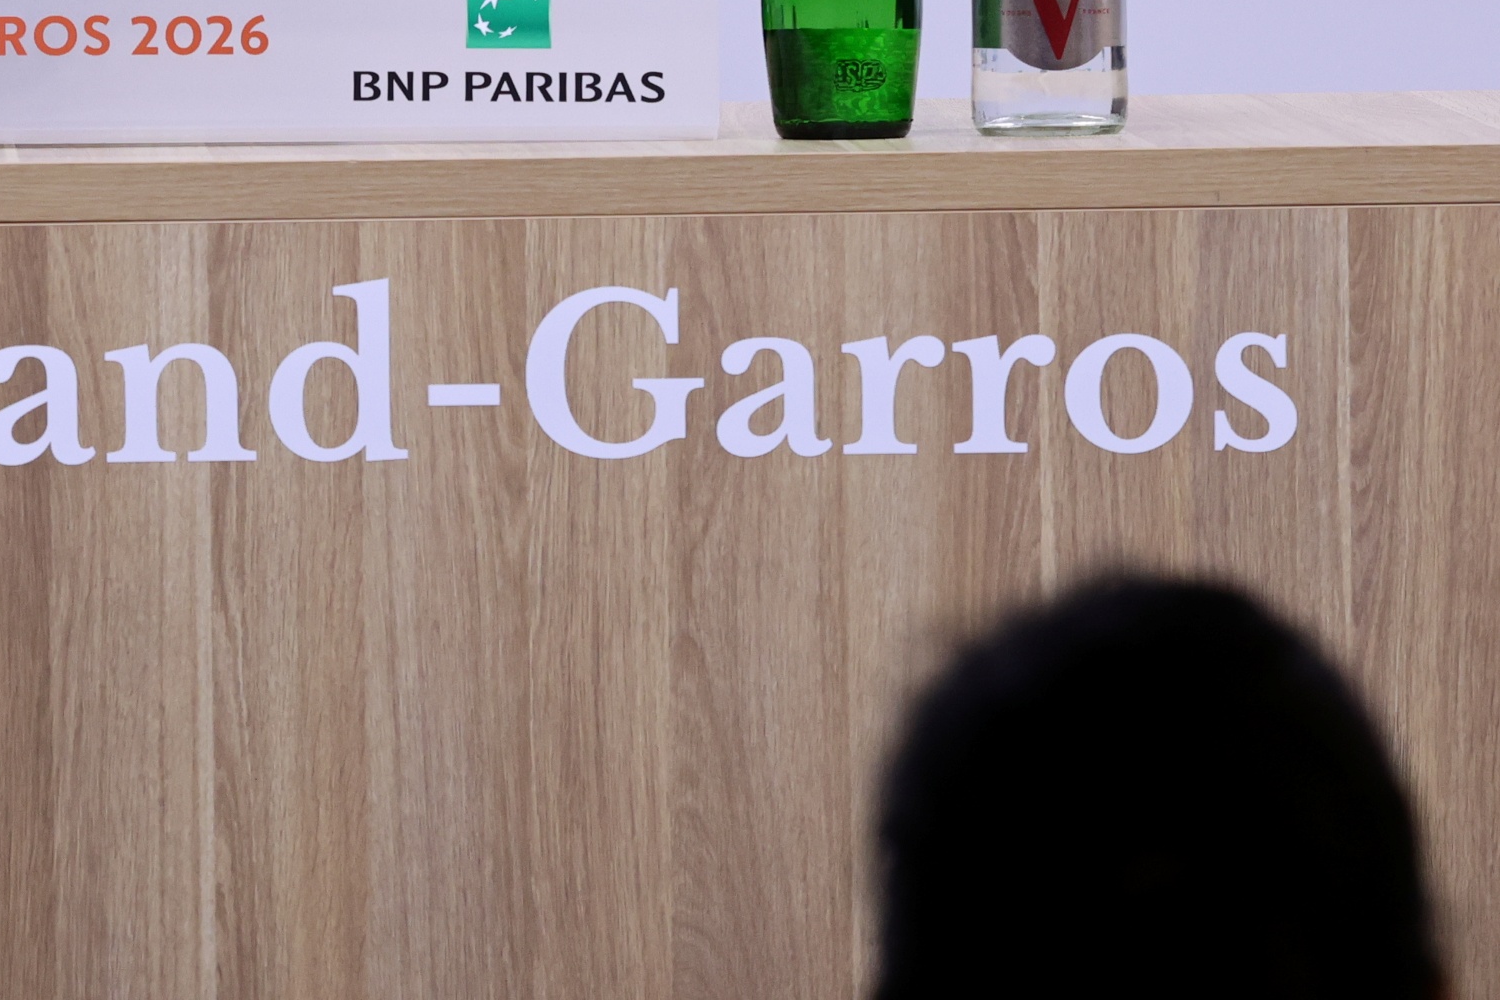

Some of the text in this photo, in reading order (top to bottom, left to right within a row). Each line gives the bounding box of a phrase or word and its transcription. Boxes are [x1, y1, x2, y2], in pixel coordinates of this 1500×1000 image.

[131, 15, 269, 56] 2026
[353, 71, 666, 104] BNP PARIBAS
